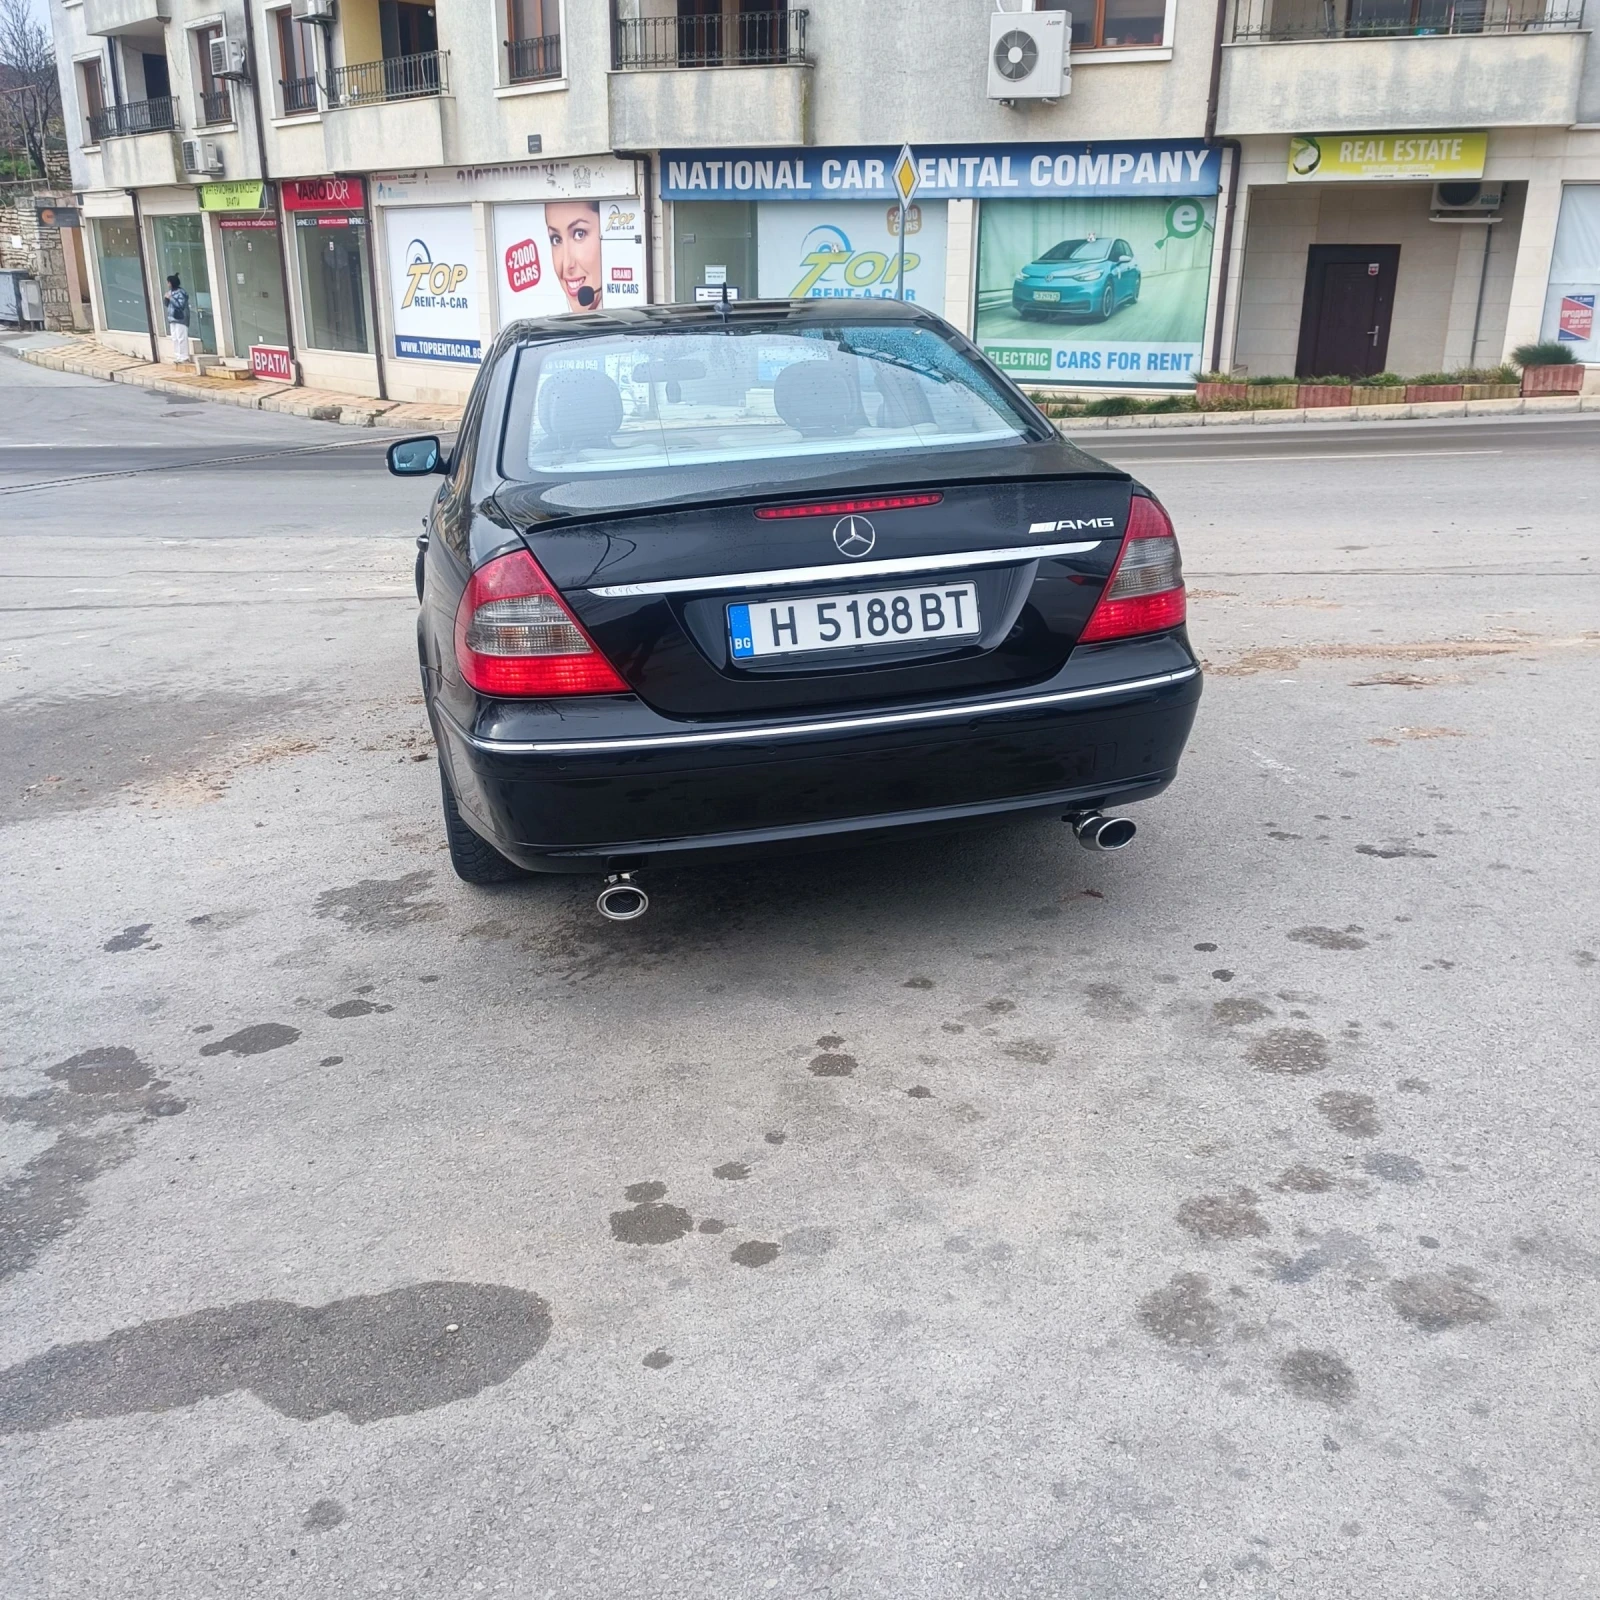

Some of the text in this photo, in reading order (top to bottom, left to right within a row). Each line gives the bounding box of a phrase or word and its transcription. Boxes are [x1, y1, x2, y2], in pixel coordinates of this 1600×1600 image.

[1339, 138, 1463, 163] REAL ESTATE
[668, 150, 1210, 190] NATIONAL CAR ENTAL COMPANY
[605, 212, 635, 232] TOP
[888, 208, 918, 223] +200
[893, 221, 918, 234] CRS
[507, 243, 536, 270] +2000
[513, 264, 539, 286] CARS
[612, 269, 632, 279] BRAND
[788, 250, 921, 298] TOP
[401, 262, 468, 309] TOP
[607, 284, 639, 294] NEW CARS
[414, 296, 468, 309] RENT-A-CAR
[253, 351, 289, 374] ВРАТИ
[987, 350, 1193, 371] ELECTRIC CARS FOR RENT
[1056, 518, 1115, 531] AMG
[770, 605, 799, 647] H
[734, 637, 751, 650] BG
